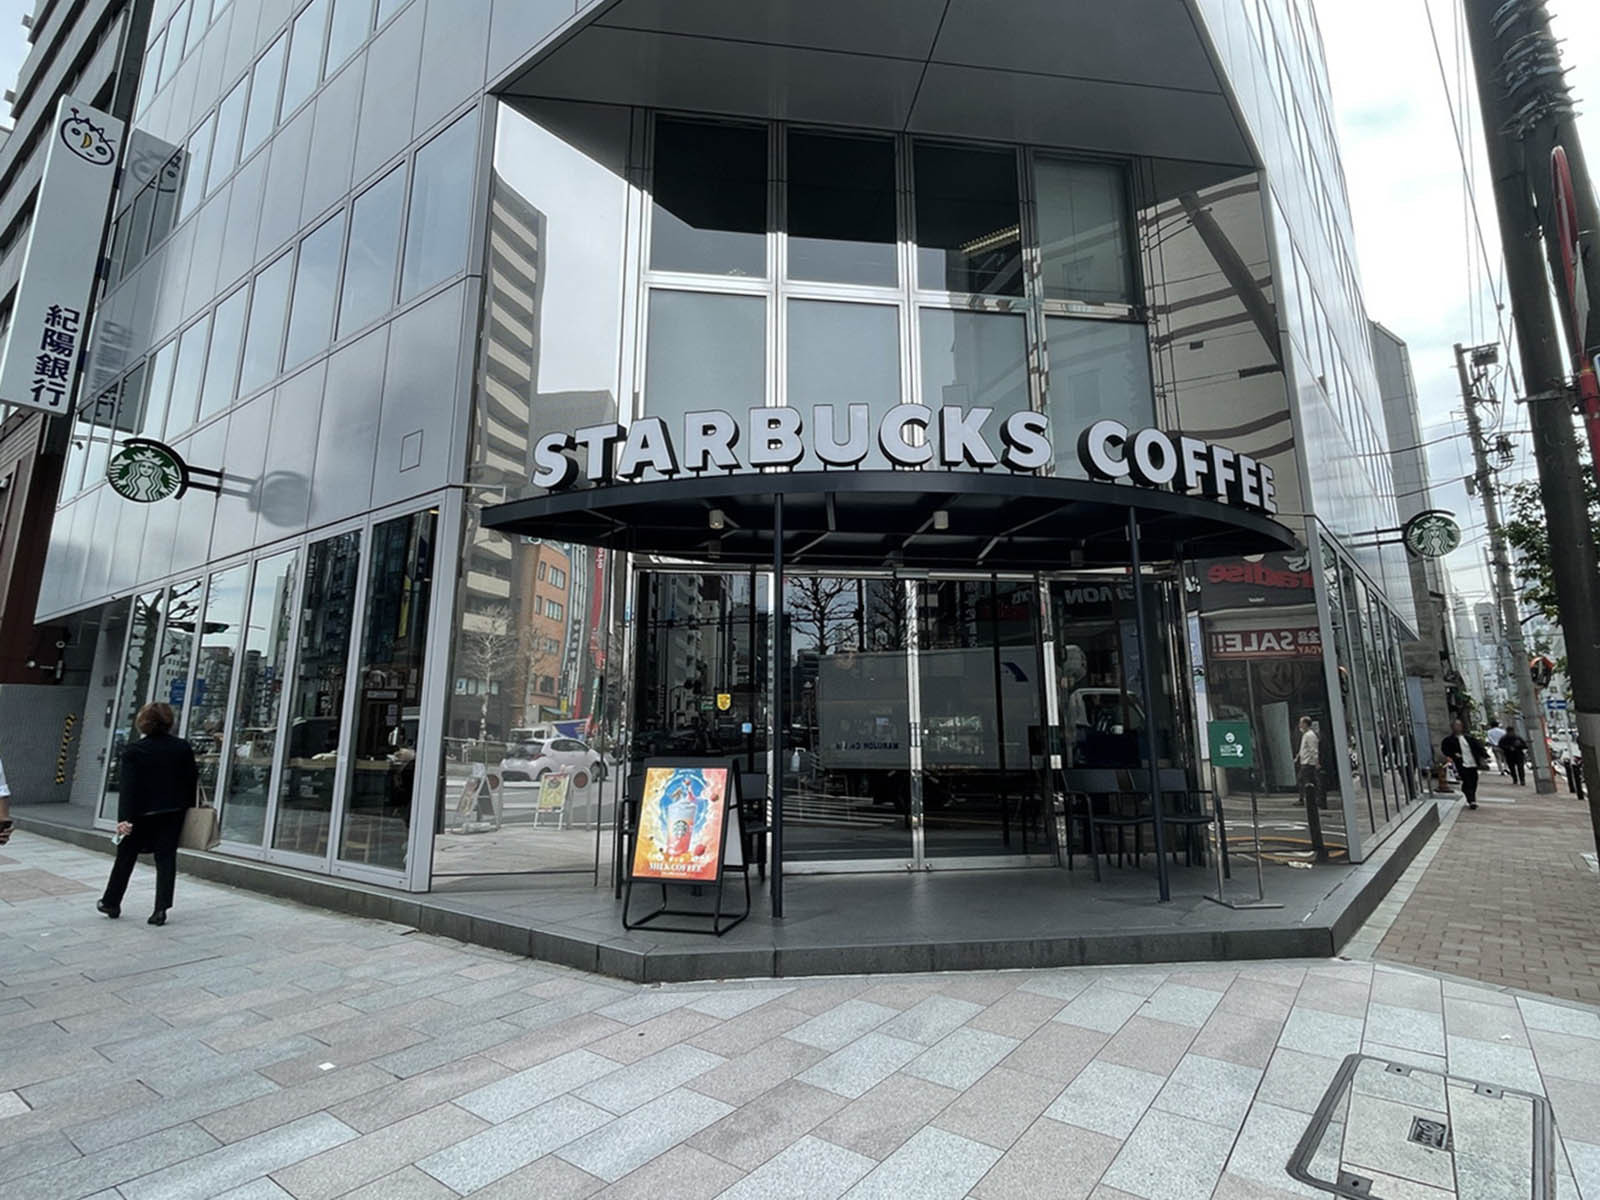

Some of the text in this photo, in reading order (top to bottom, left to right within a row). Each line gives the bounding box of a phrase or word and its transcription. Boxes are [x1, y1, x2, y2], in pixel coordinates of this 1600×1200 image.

[30, 304, 80, 406] 紀陽銀行
[531, 403, 1278, 514] STARBUCKS COFFEE
